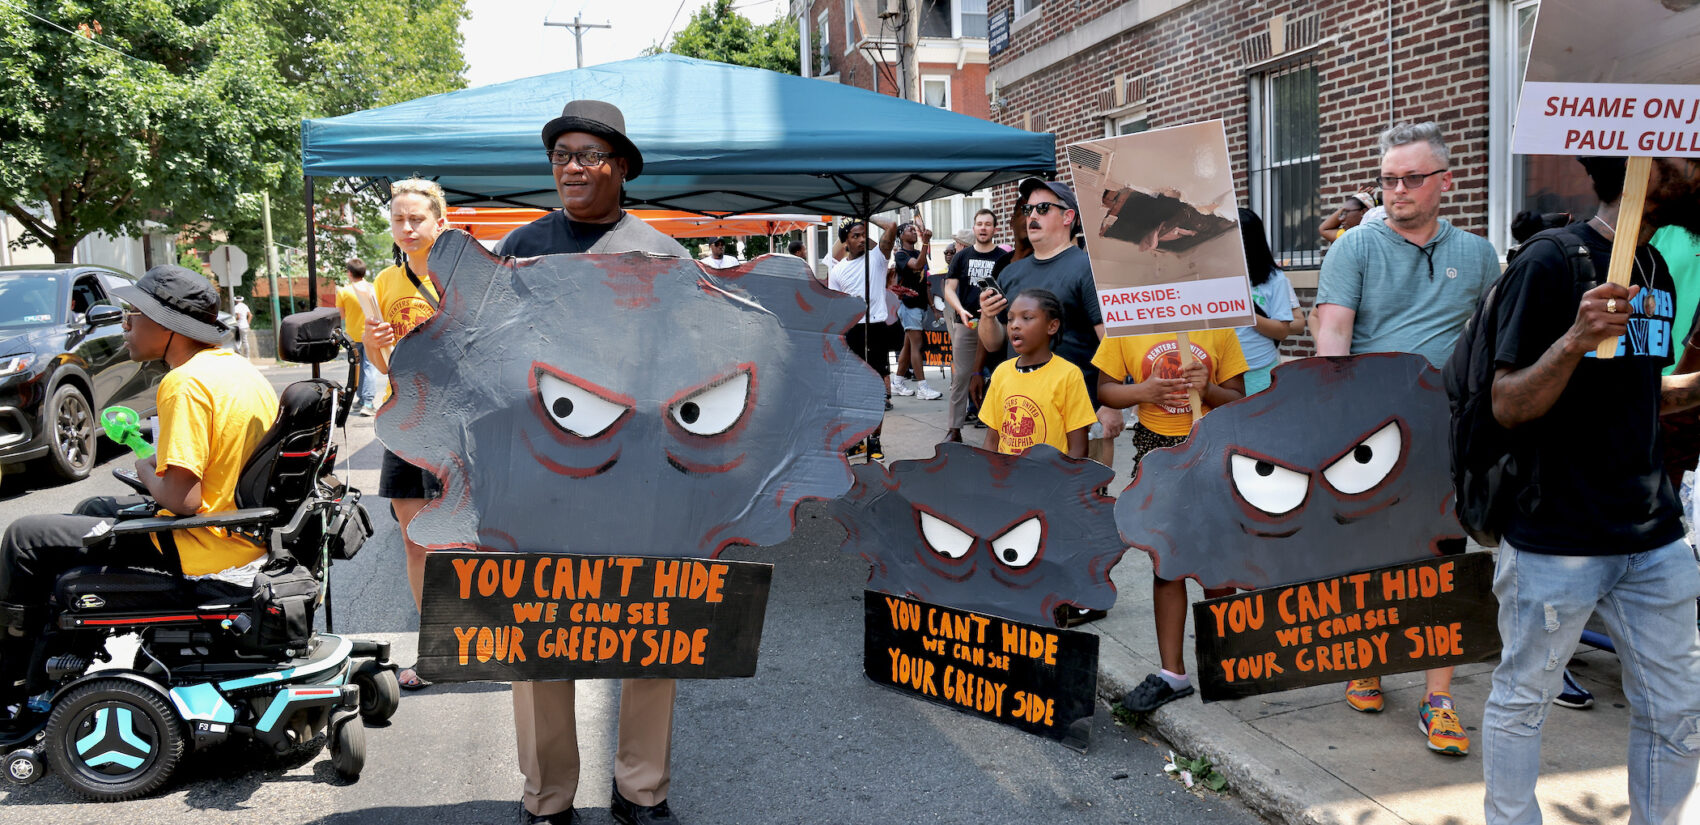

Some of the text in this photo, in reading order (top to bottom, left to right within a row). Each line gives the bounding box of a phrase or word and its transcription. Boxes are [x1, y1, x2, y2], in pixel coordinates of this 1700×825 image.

[1544, 96, 1637, 118] SHAME
[1643, 98, 1685, 119] ON
[1564, 129, 1629, 150] PAUL
[1101, 288, 1181, 306] PARKSIDE:
[1106, 299, 1246, 322] ALL EYES ON ODIN
[925, 331, 942, 344] YOU
[1147, 343, 1176, 361] RENTERS
[453, 557, 728, 602] YOU CAN'T HIDE
[513, 602, 669, 625] WE CAN SEE
[1210, 562, 1454, 637] YOU CAN'T HIDE
[886, 597, 1058, 665] YOU CAN'T HIDE
[1276, 607, 1399, 647] WE CAN SEE
[454, 626, 709, 666] YOUR GREEDY SIDE
[923, 636, 1010, 671] WE CAN SEE
[1221, 623, 1464, 682] YOUR GREEDY SIDE
[888, 648, 1054, 726] YOUR GREEDY SIDE
